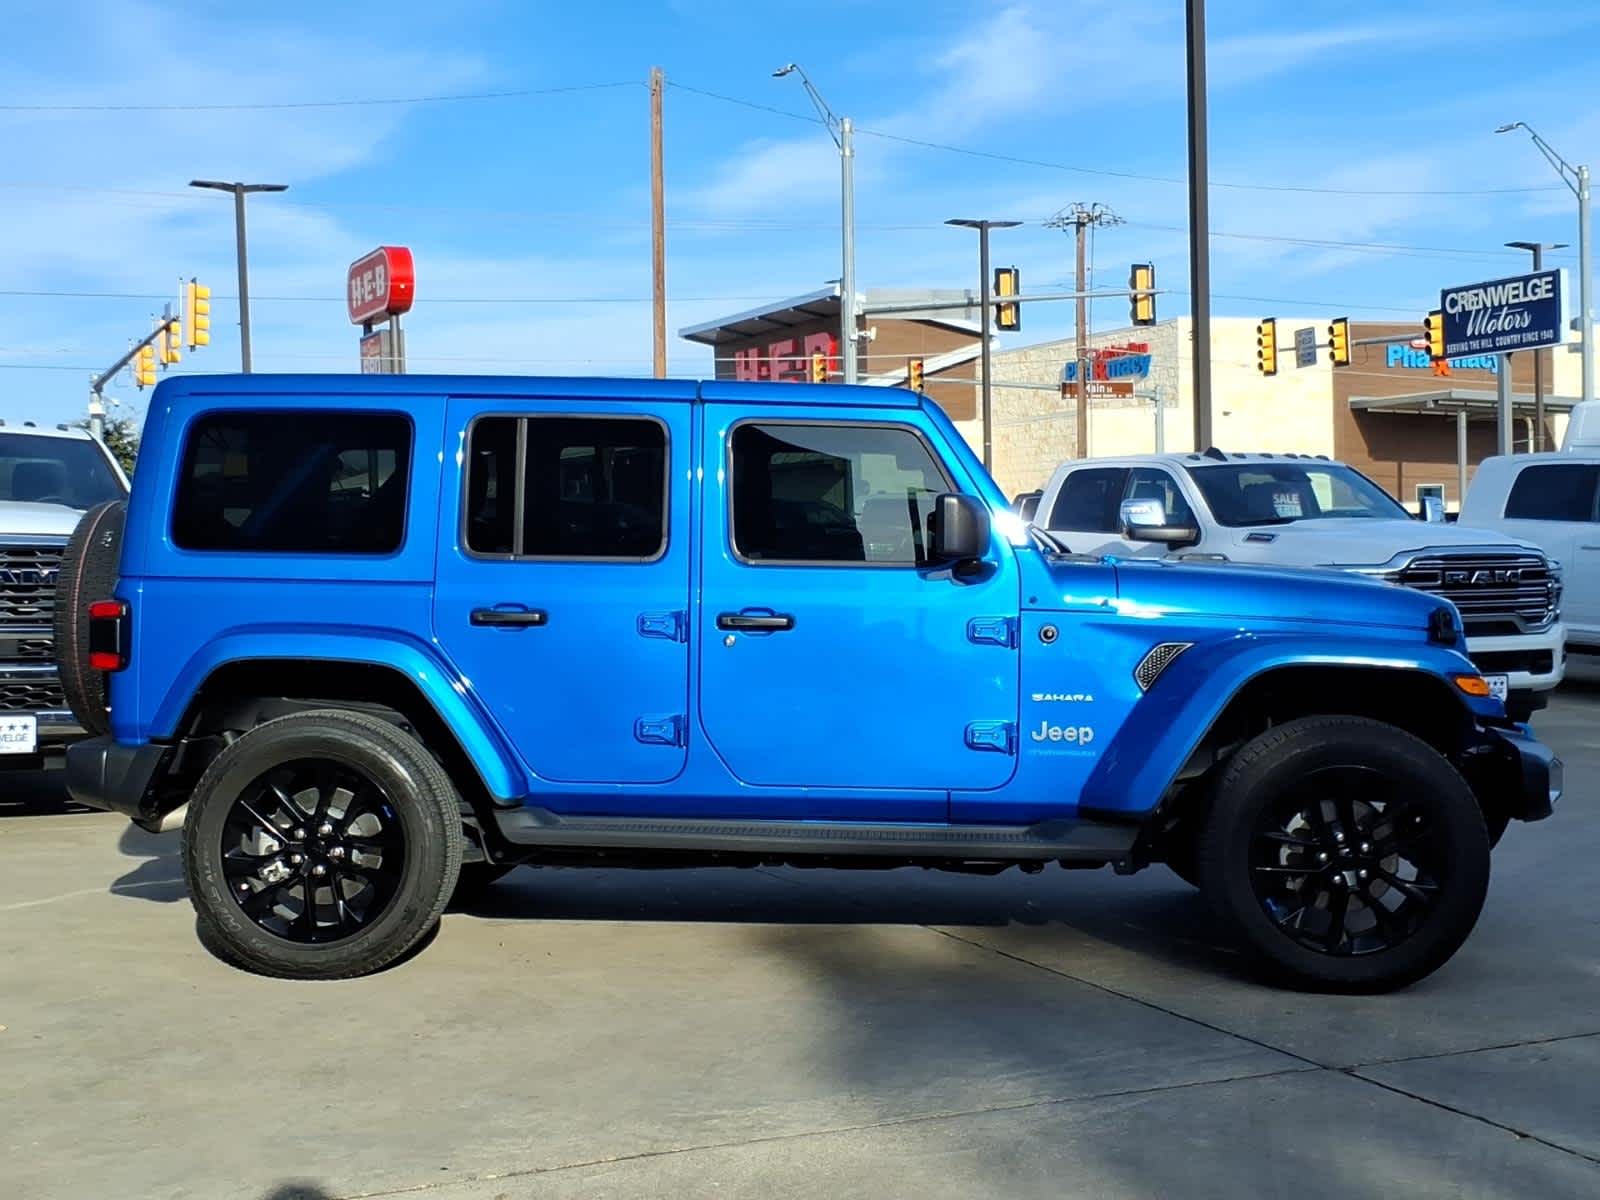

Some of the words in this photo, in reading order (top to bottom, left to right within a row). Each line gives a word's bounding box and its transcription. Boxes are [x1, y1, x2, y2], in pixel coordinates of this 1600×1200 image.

[1445, 277, 1554, 314] CRENWELGE
[1463, 303, 1532, 337] Motors
[1446, 343, 1468, 354] SERVING
[1470, 340, 1480, 350] THE
[1481, 338, 1493, 349] HILL
[1495, 335, 1521, 347] COUNTRY
[1522, 332, 1539, 343] SINCE
[1272, 493, 1300, 505] SALE
[1444, 569, 1521, 585] RAM
[1031, 693, 1094, 702] SAHARA
[1031, 720, 1094, 746] Jeep
